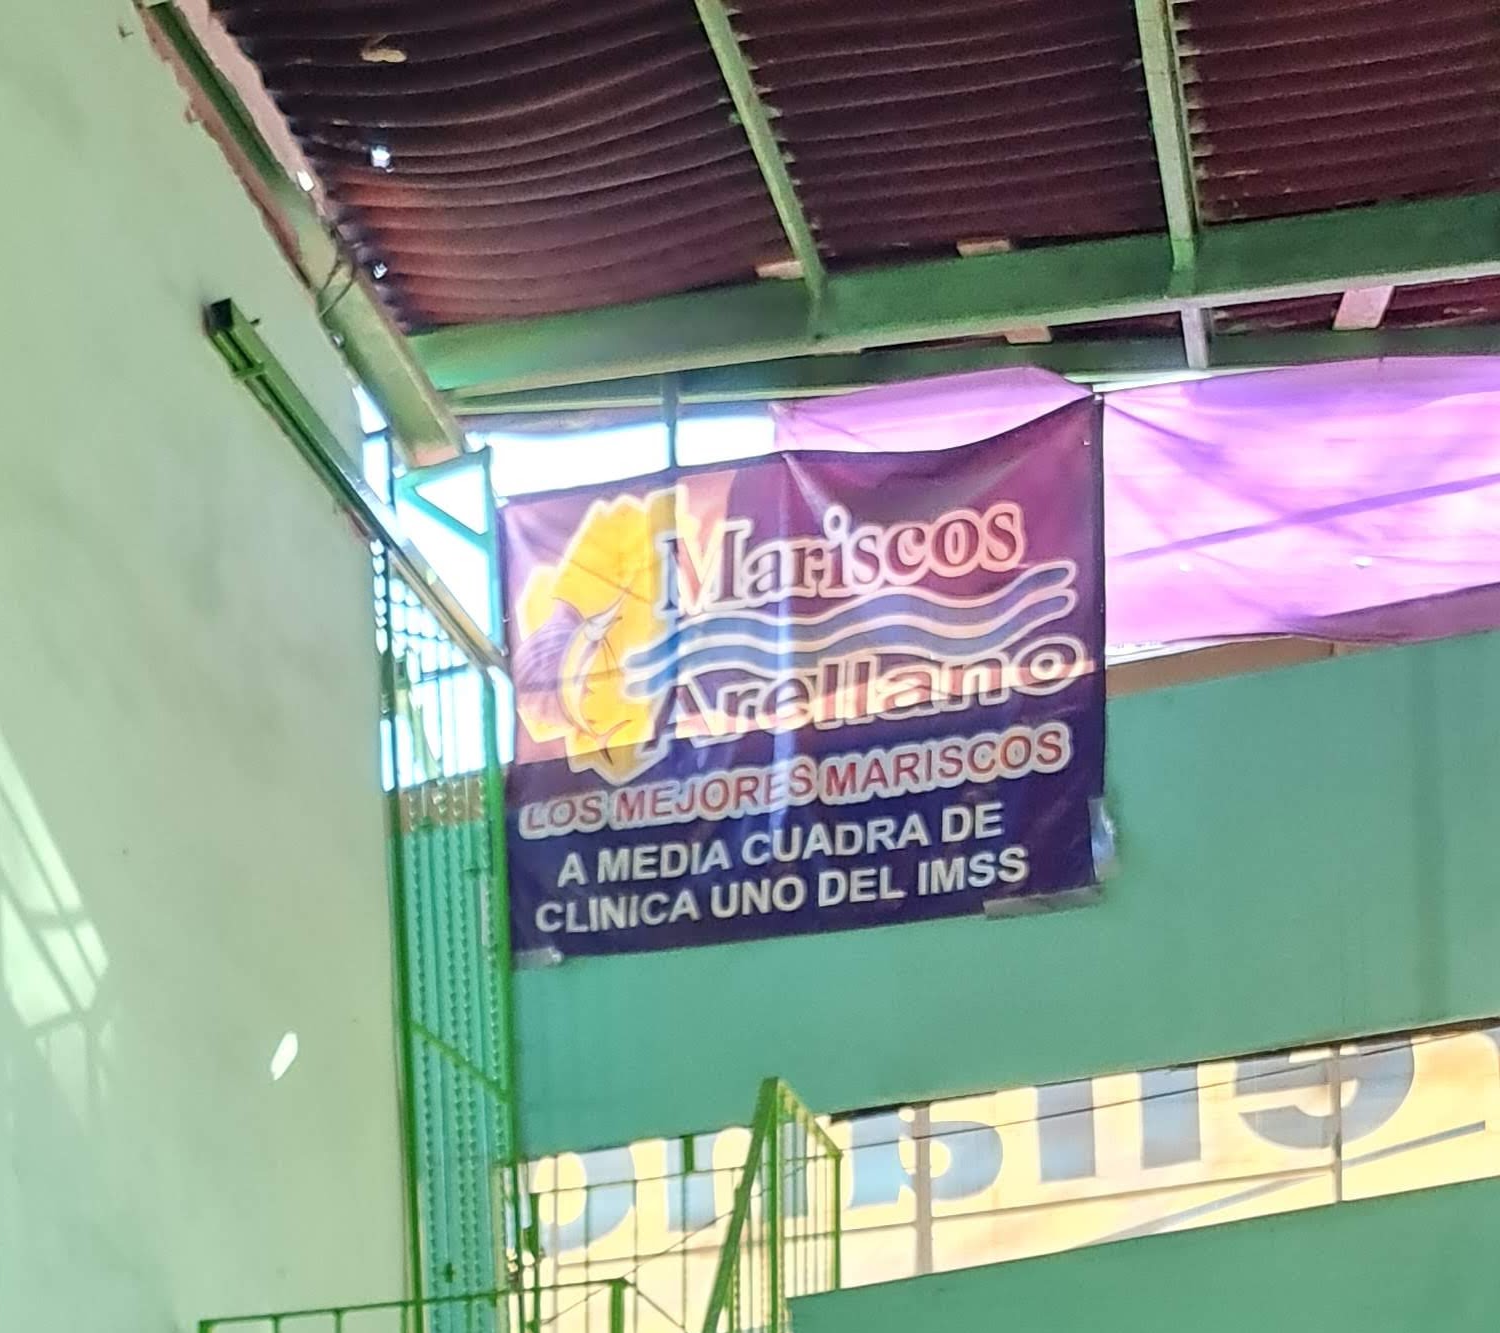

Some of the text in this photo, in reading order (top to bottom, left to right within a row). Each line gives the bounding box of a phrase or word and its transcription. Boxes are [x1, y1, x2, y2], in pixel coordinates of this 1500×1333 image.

[658, 504, 1025, 616] Mariscos
[646, 638, 1086, 752] Arellano
[521, 724, 1068, 835] LOS MEJORES MARISCOS
[534, 846, 1030, 935] CLINICA UNO DEL IMSS
[556, 801, 1005, 888] A MEDIA CUADRA DE
